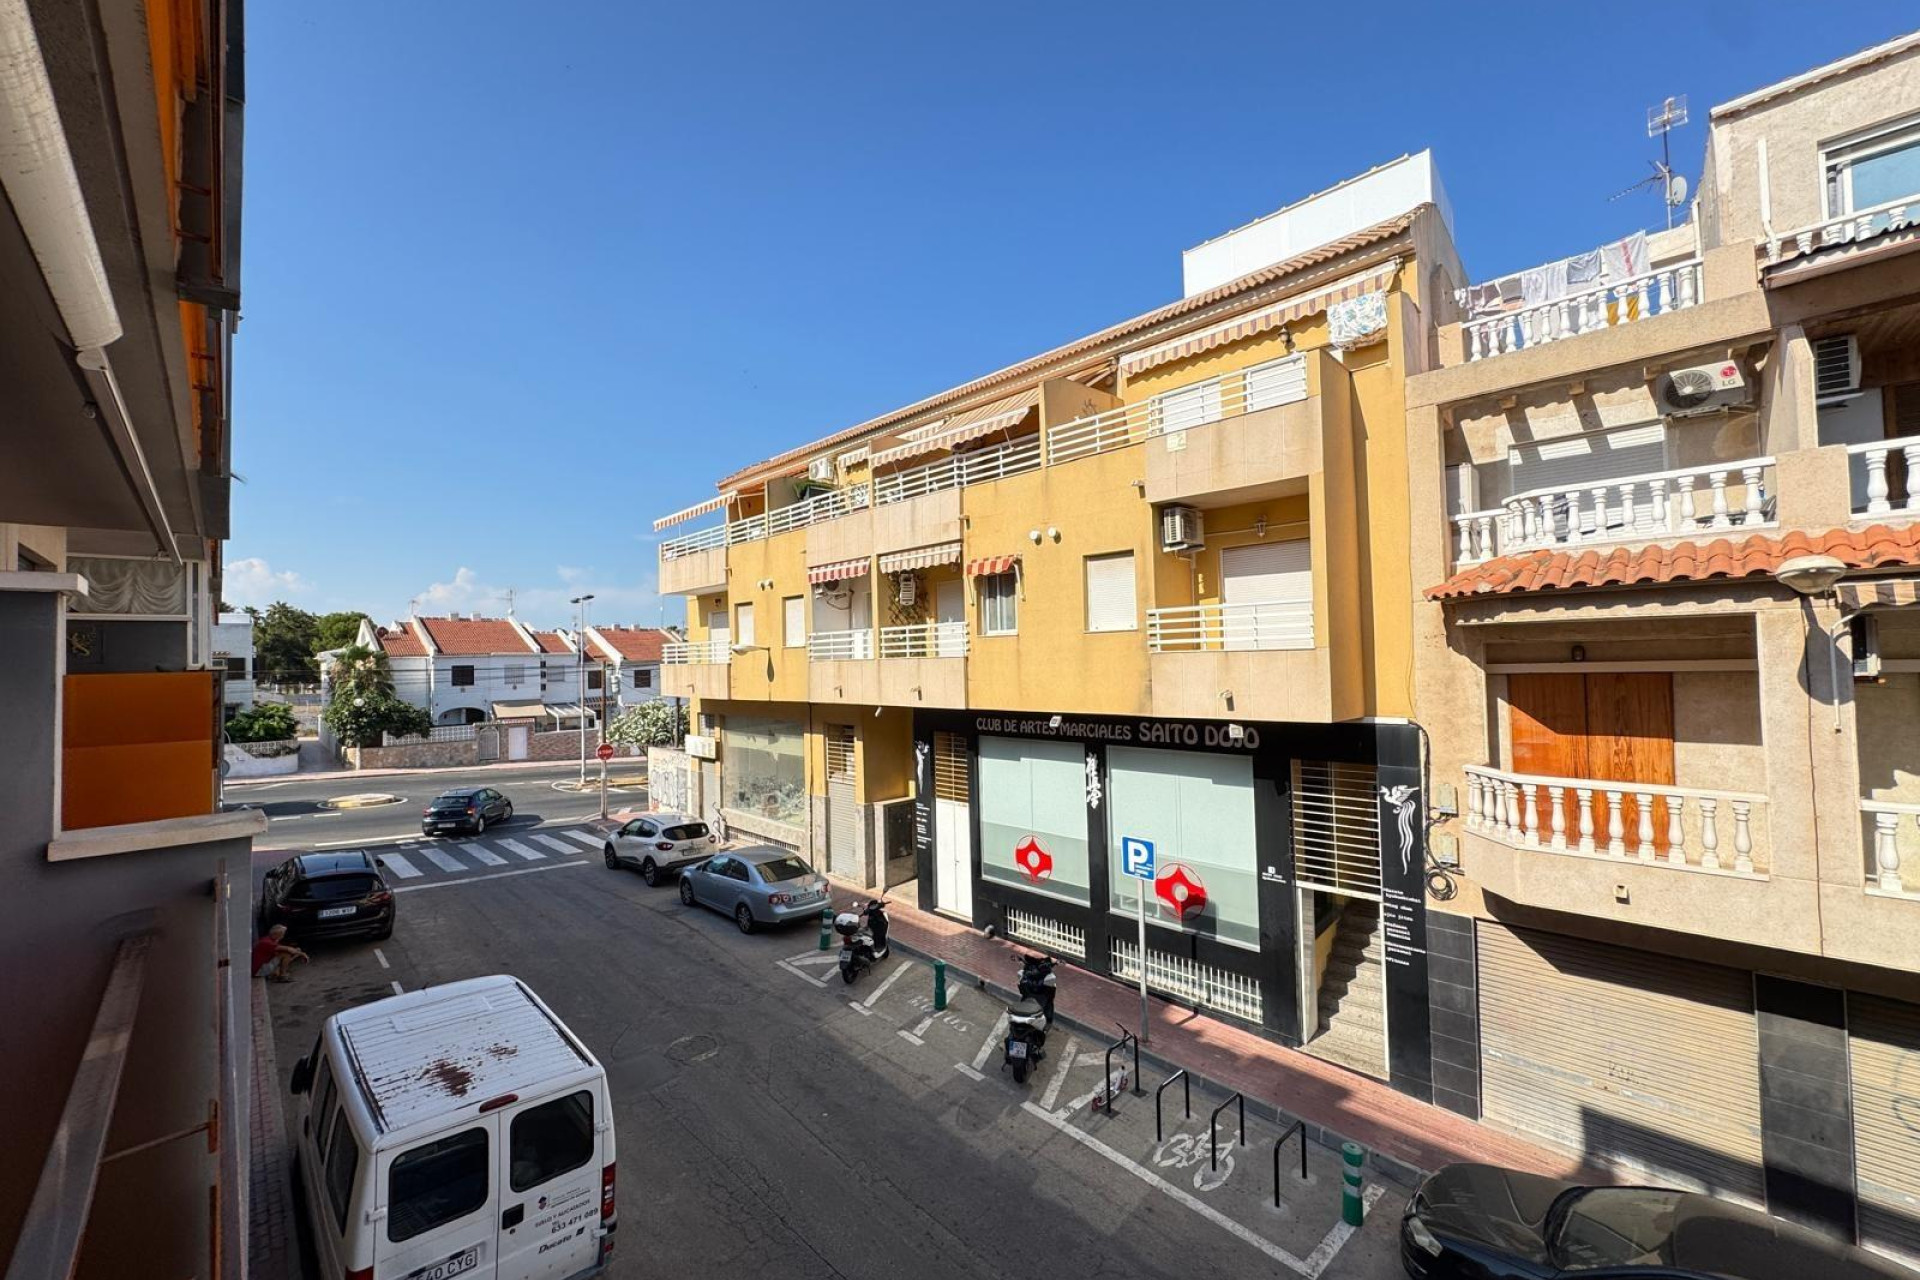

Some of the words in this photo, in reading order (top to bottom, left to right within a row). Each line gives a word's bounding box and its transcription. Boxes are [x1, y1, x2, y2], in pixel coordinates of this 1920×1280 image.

[1721, 378, 1736, 388] LG
[976, 717, 1001, 732] CLUB
[1003, 719, 1018, 733] DE
[1019, 720, 1057, 736] ARTES
[1060, 721, 1132, 740] MARCIALES
[1139, 722, 1199, 745] SAITO
[1127, 840, 1149, 874] P
[568, 1214, 582, 1226] 471
[538, 1235, 572, 1254] Ducato
[447, 1253, 474, 1275] CYG
